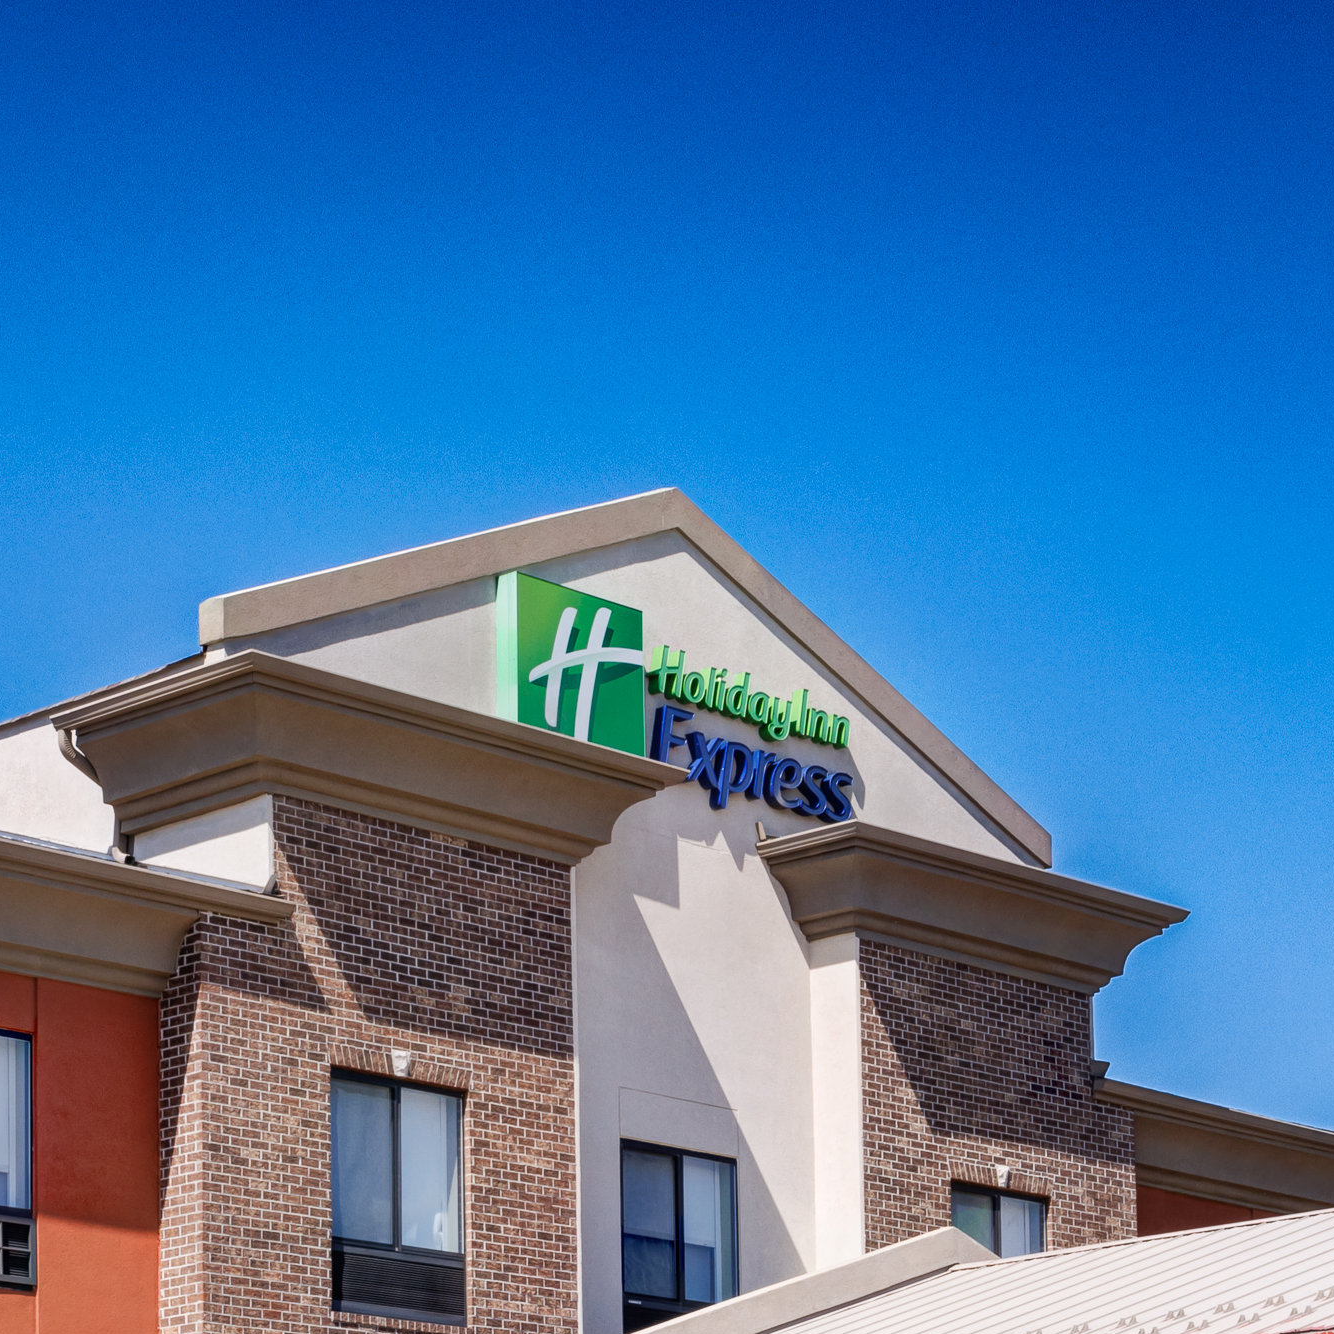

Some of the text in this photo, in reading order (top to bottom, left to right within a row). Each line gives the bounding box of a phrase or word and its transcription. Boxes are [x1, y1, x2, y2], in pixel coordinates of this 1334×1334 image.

[646, 644, 851, 750] Holiday Inn
[650, 704, 854, 823] Express
